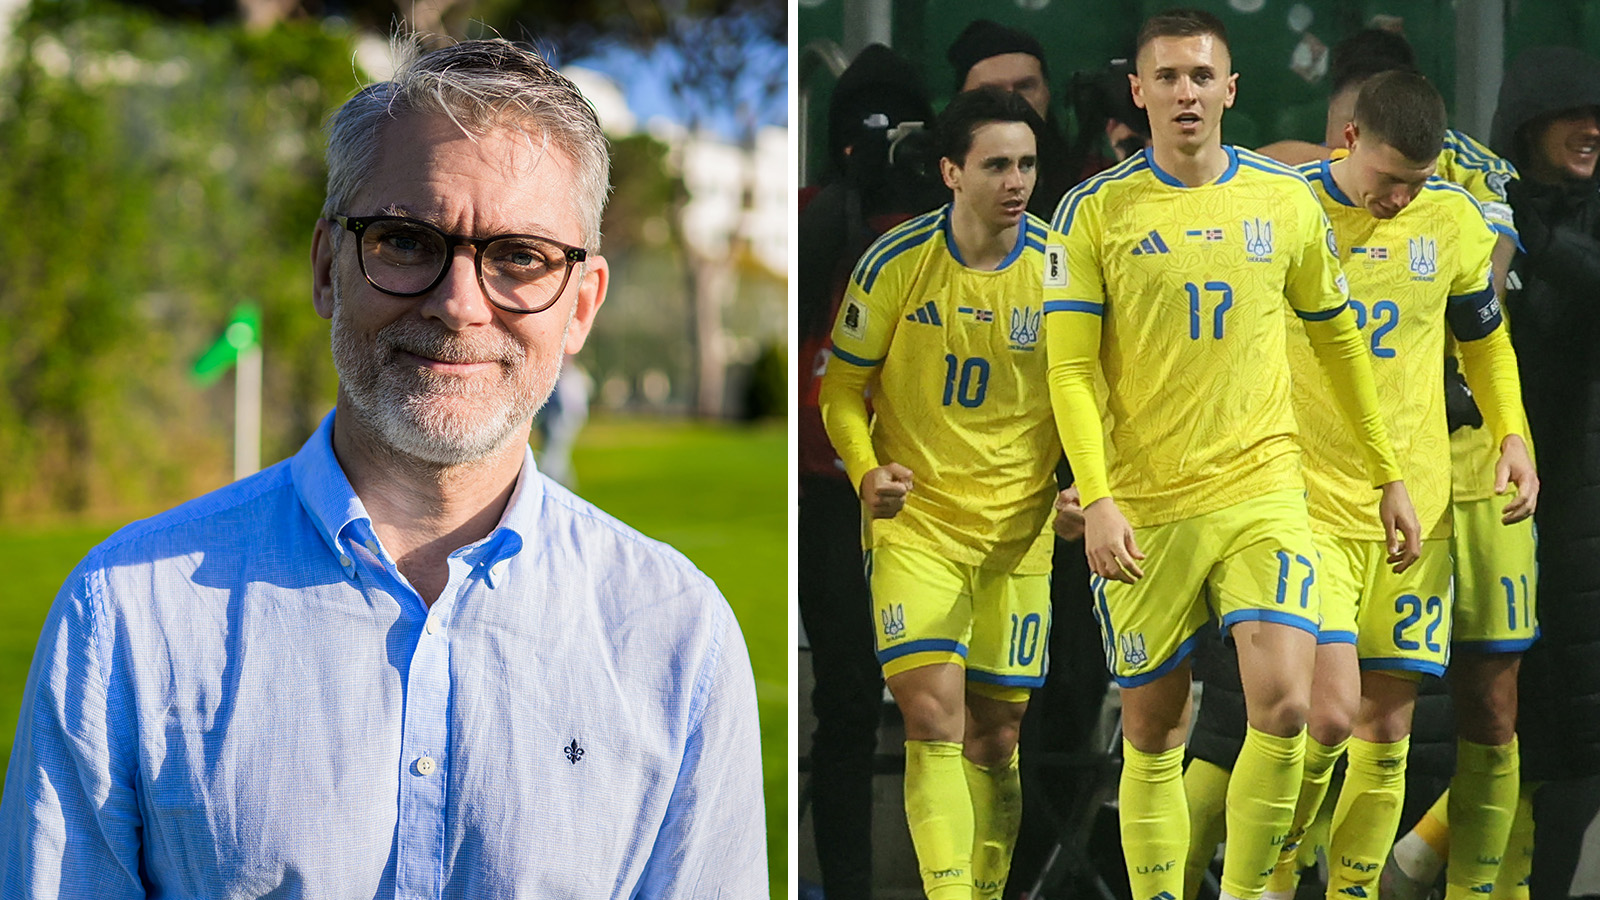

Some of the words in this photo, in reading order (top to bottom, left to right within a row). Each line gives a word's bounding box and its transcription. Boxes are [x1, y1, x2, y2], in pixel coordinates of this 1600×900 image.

[1185, 281, 1232, 340] 17
[943, 354, 989, 408] 10
[1275, 550, 1315, 608] 17
[1500, 574, 1529, 631] 11
[1009, 613, 1041, 667] 10
[1393, 594, 1442, 653] 22
[1136, 860, 1176, 875] UAF
[1341, 856, 1379, 872] UAF
